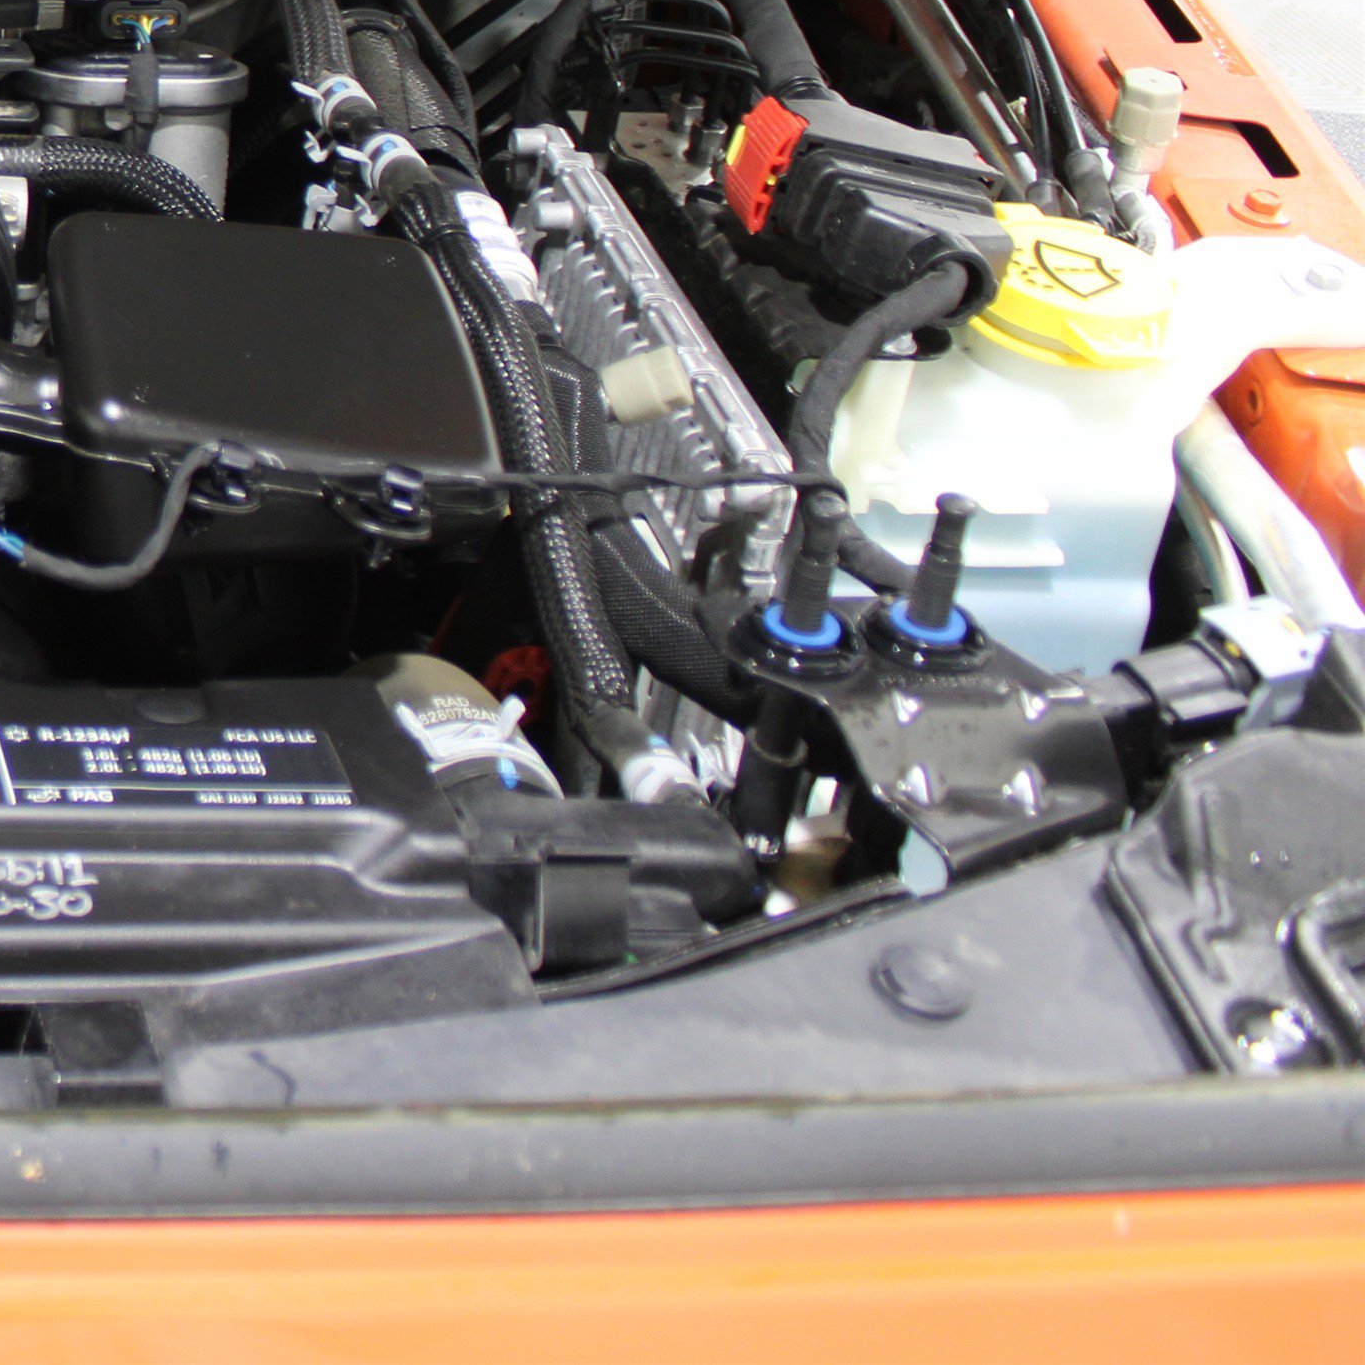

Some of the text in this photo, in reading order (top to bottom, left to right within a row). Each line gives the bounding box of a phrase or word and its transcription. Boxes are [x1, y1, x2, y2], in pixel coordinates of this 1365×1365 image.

[432, 696, 470, 708] RAD
[225, 729, 317, 744] FCA US LLC
[70, 788, 114, 803] PAG
